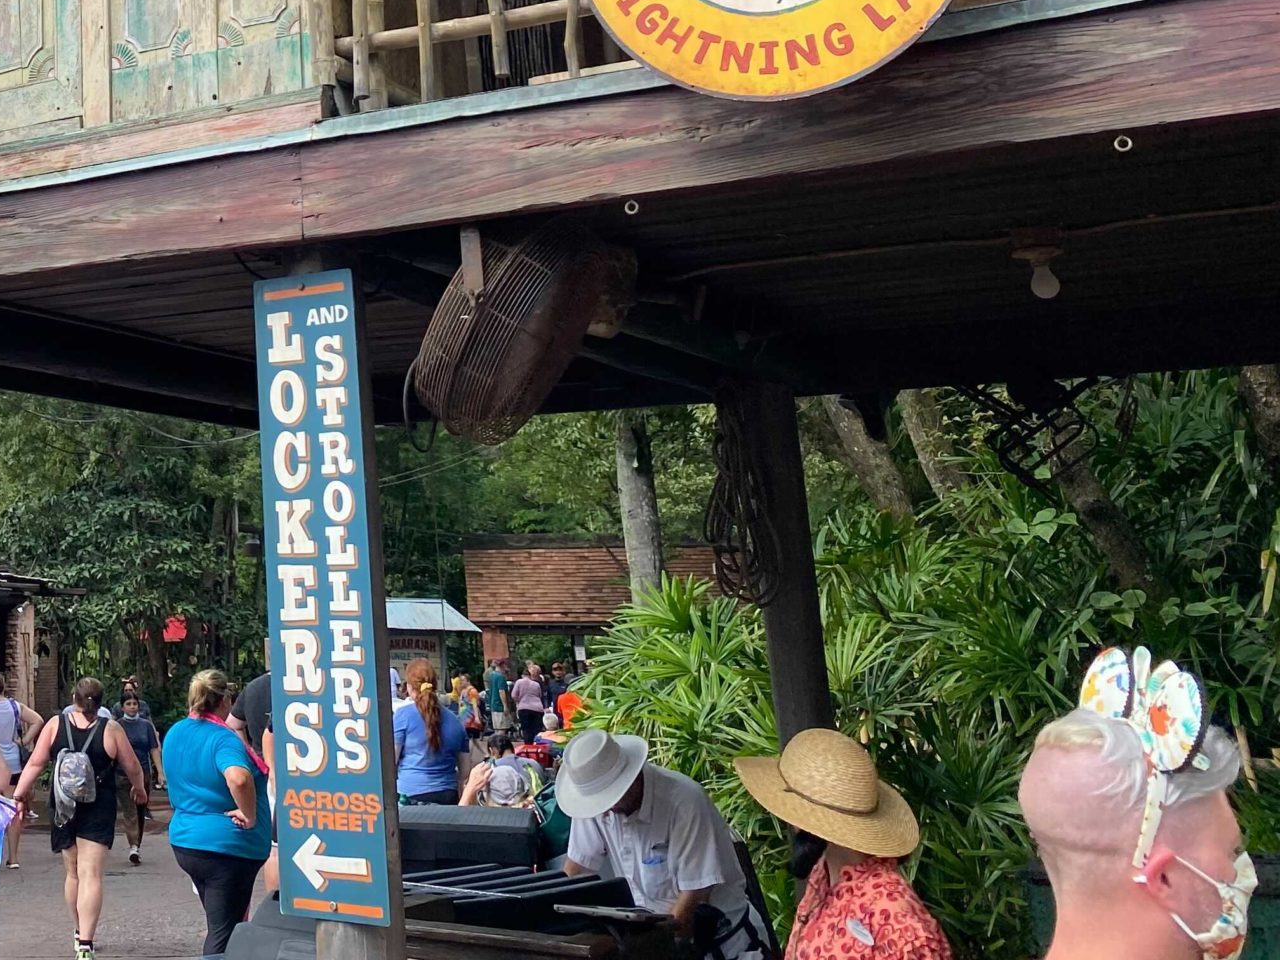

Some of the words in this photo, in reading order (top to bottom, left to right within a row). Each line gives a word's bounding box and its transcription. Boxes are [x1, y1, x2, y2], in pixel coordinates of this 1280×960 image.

[306, 304, 349, 326] AND
[266, 311, 326, 773] LOCKERS
[314, 334, 369, 772] STROLLERS
[283, 788, 382, 814] ACROSS
[289, 808, 378, 833] STREET
